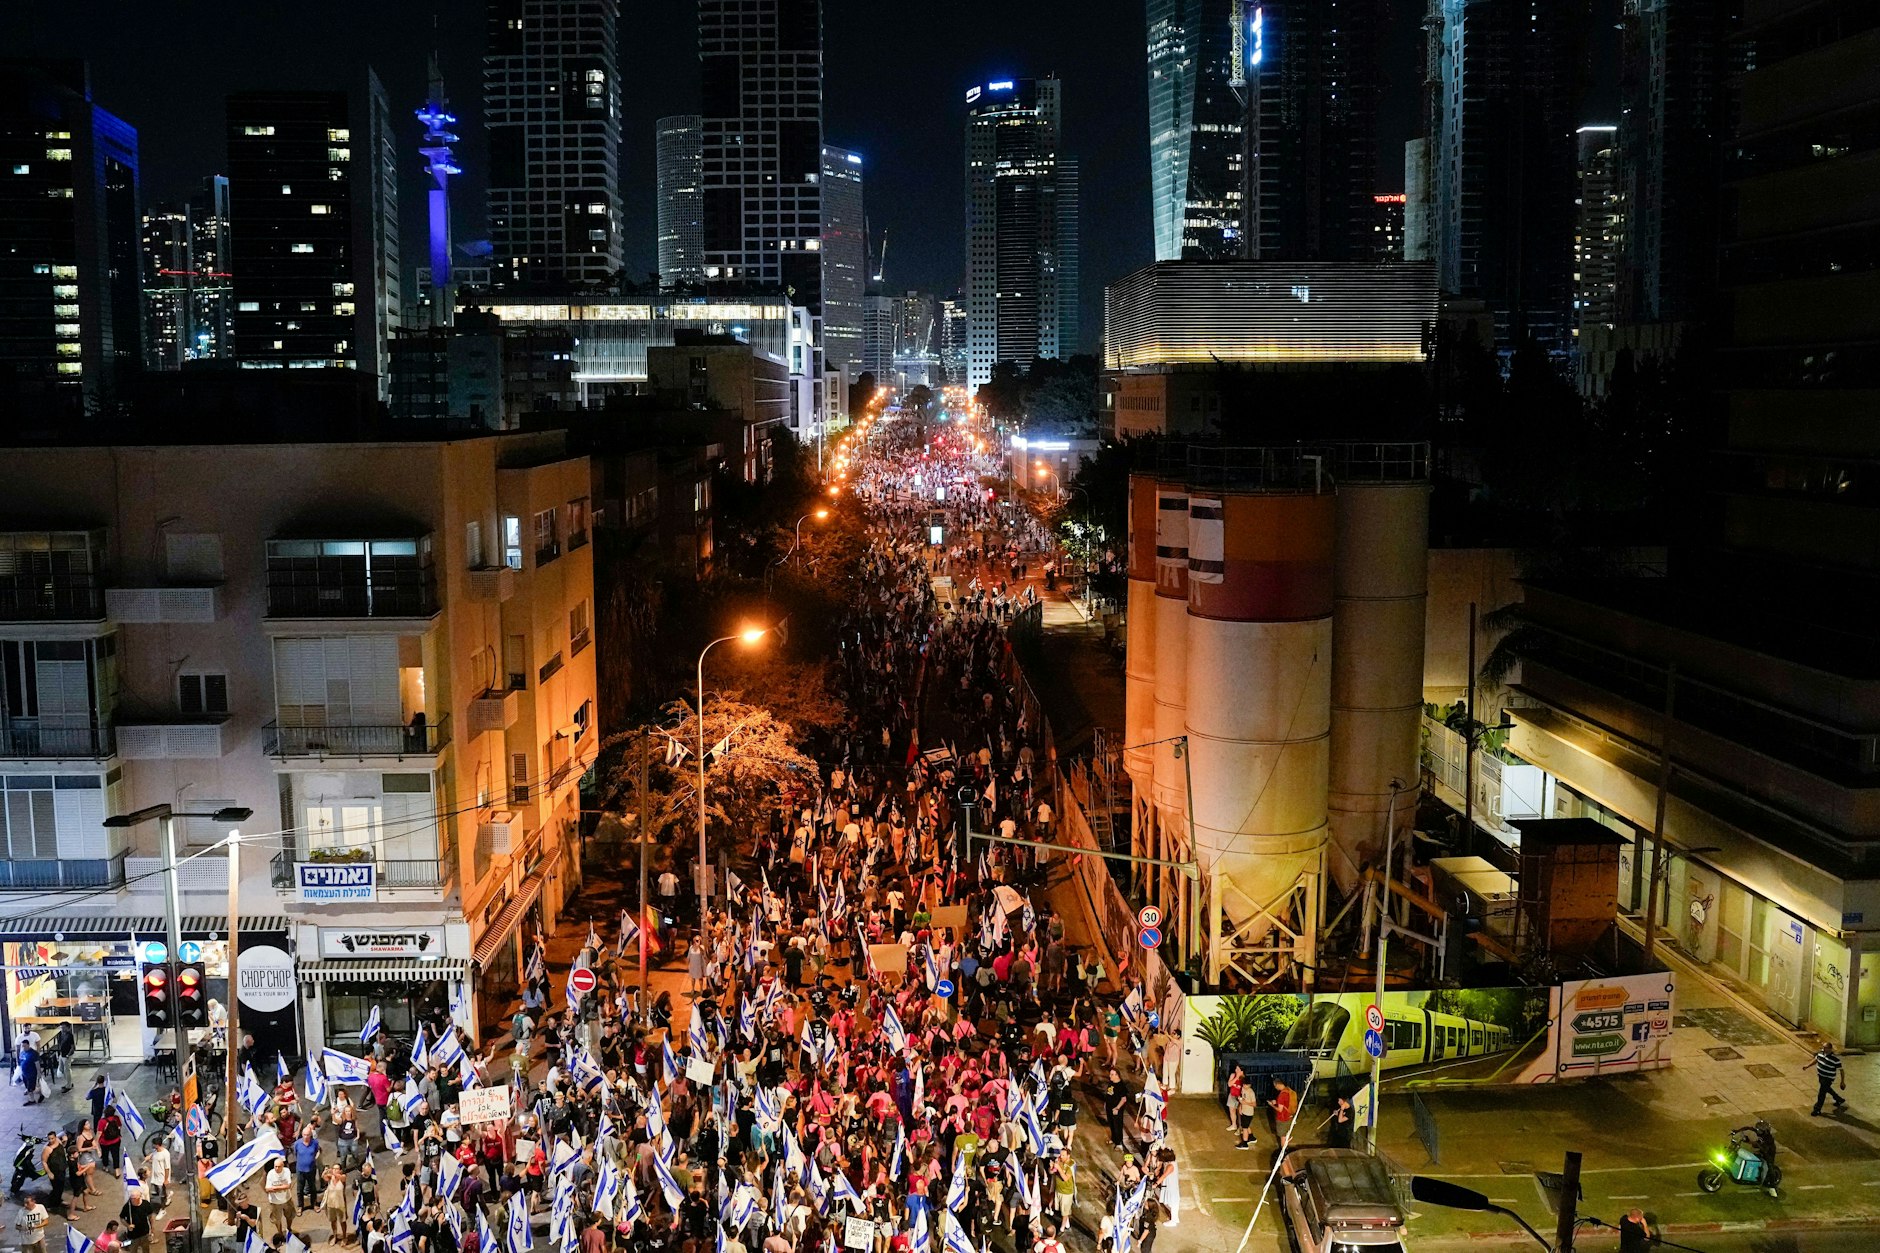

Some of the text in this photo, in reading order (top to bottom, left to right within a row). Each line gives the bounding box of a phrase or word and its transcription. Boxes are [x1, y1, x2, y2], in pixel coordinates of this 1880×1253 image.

[304, 868, 368, 884] נאמנים
[304, 887, 371, 898] למגילת העצמאות
[1144, 912, 1157, 923] 30
[354, 934, 417, 946] המפגש
[241, 970, 291, 988] CHOP CHOP
[1370, 1012, 1380, 1026] 30
[1575, 1039, 1619, 1050] www.nta.co.il
